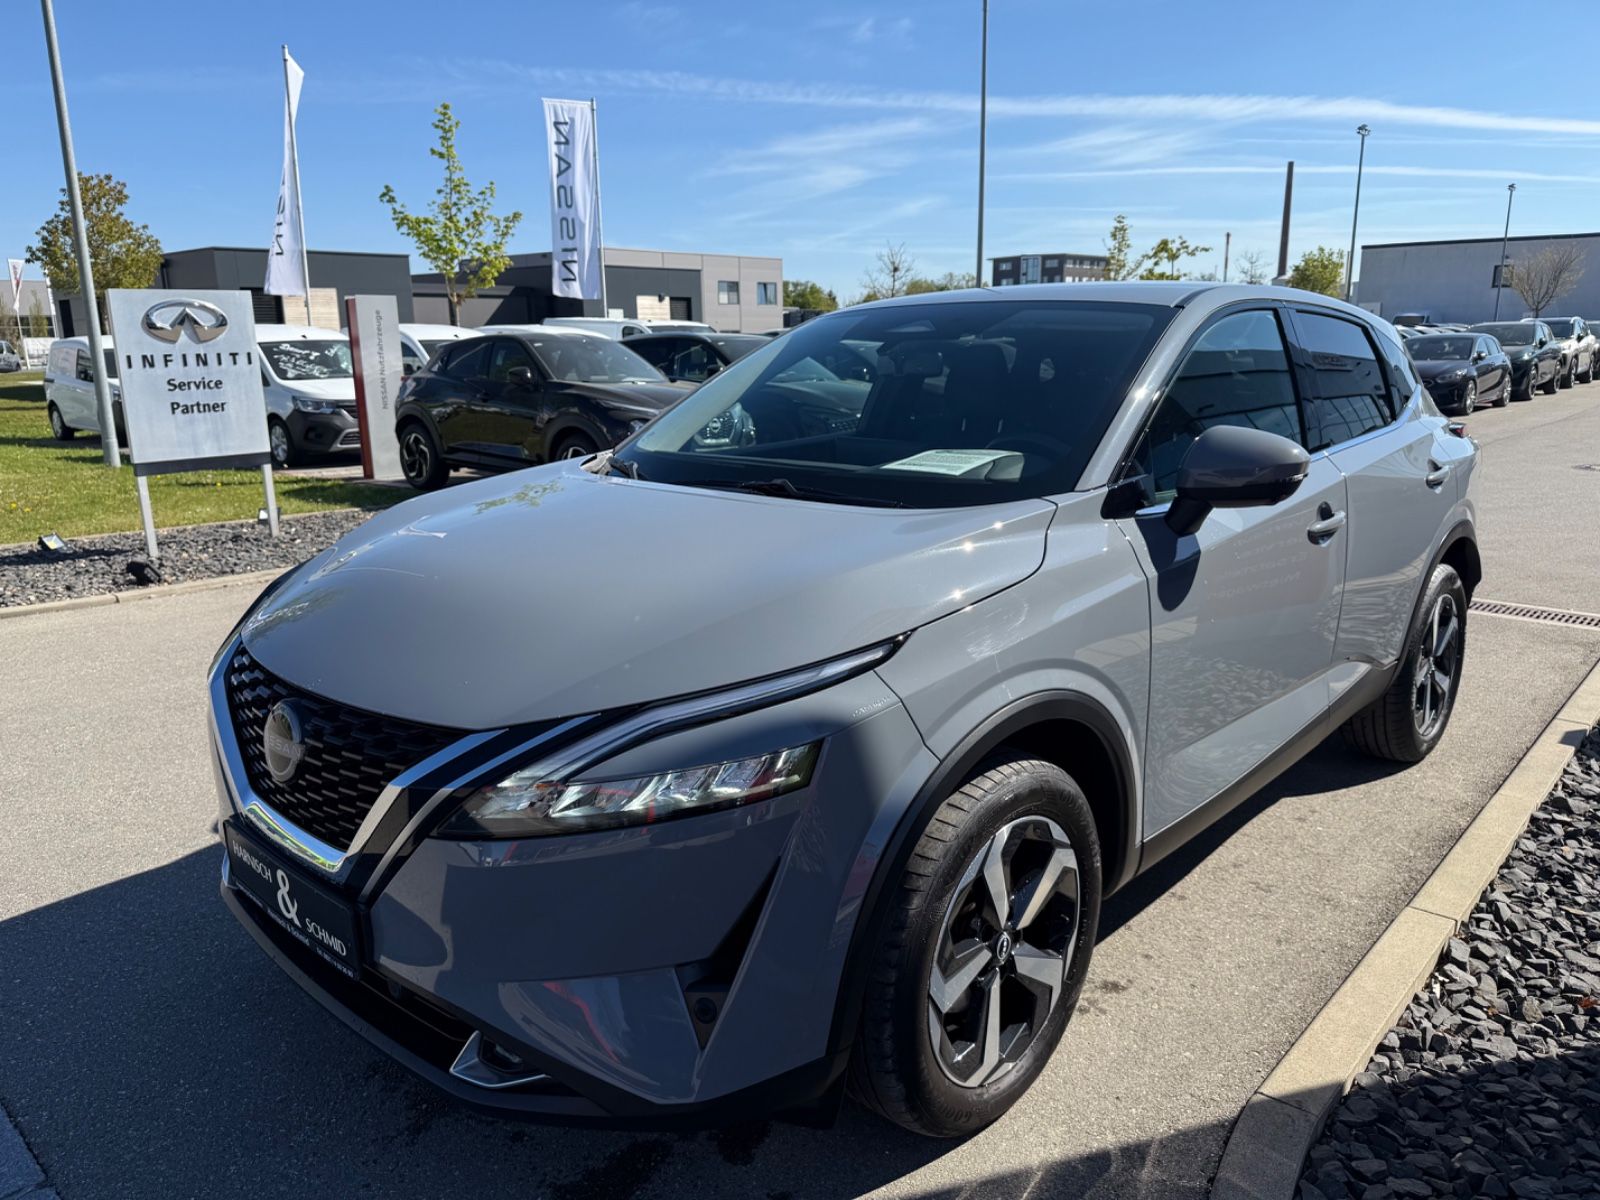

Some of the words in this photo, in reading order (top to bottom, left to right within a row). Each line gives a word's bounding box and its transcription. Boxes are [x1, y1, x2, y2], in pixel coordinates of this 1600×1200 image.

[375, 309, 385, 376] Nutzfahrzeuge
[126, 352, 253, 369] INFINITI
[166, 377, 224, 392] Service
[380, 377, 388, 409] NISSAN
[170, 401, 227, 415] Partner
[276, 868, 302, 929] &
[305, 918, 347, 957] SCHMID
